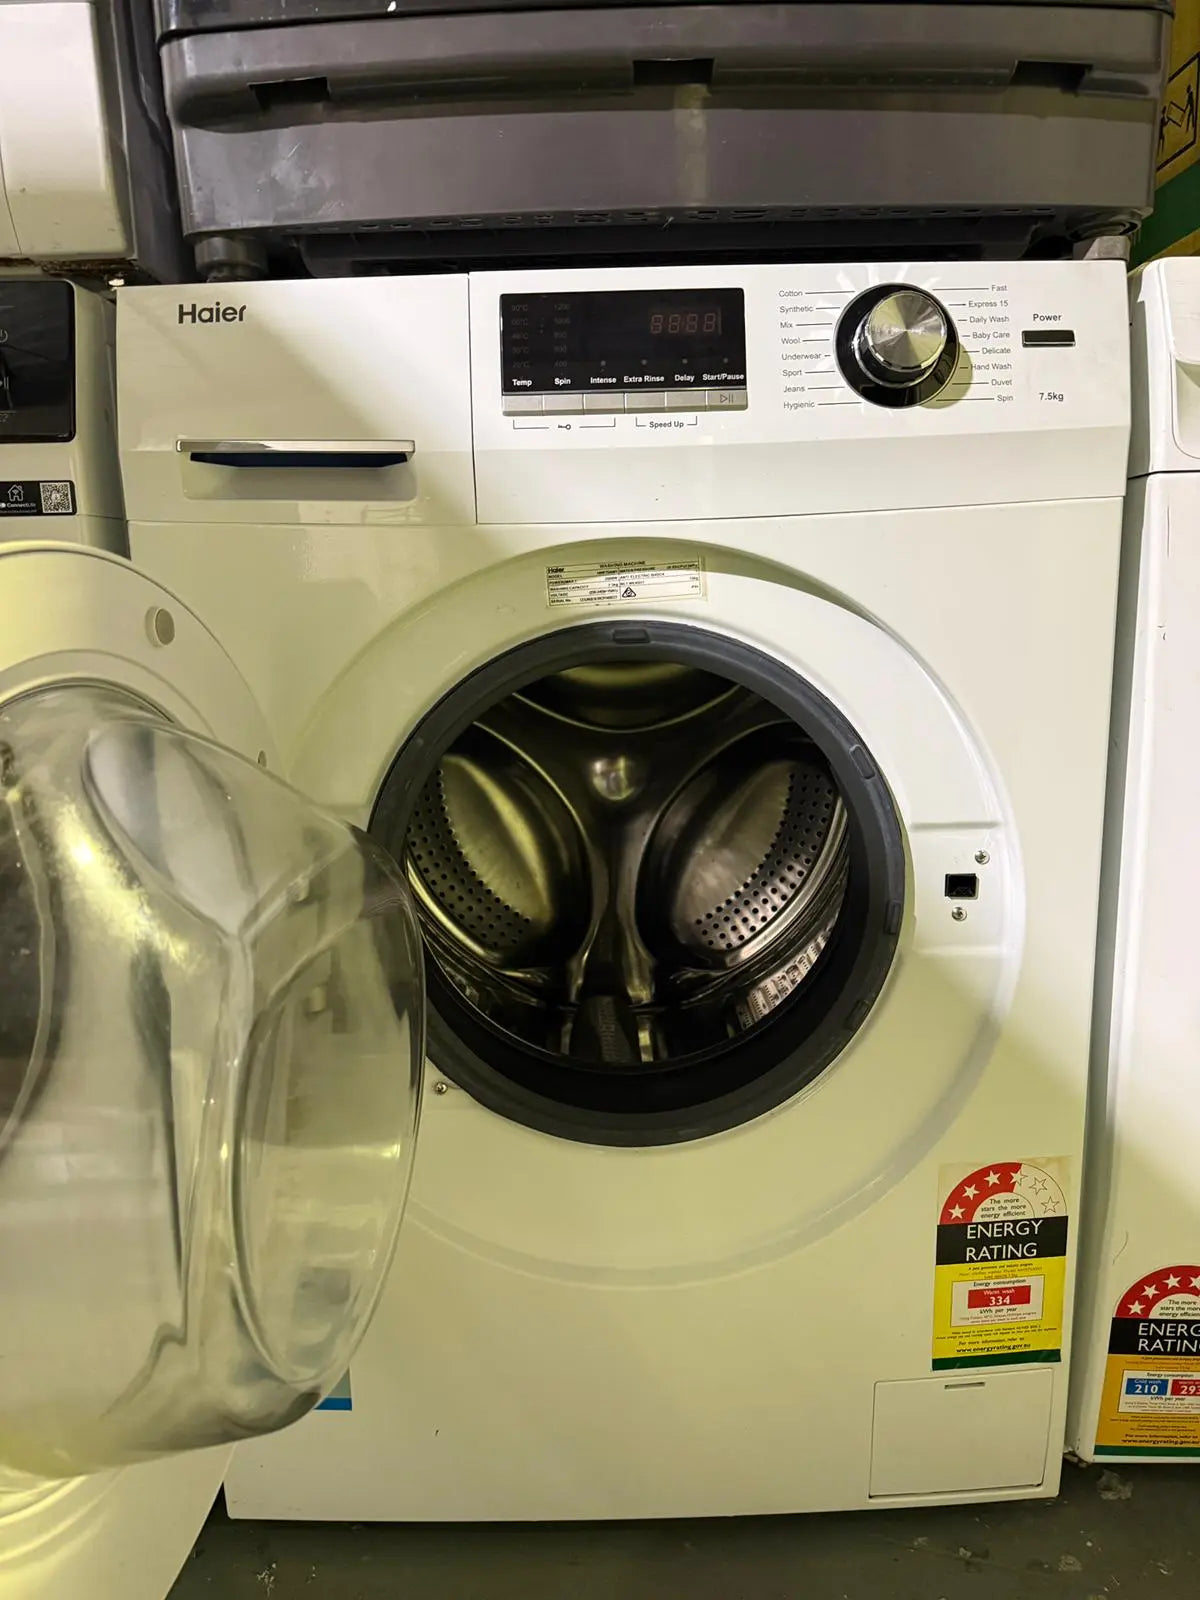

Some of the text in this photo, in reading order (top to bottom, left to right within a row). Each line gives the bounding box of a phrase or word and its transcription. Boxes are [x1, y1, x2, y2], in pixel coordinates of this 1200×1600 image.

[778, 290, 803, 298] Cotton
[968, 300, 997, 309] Express
[178, 301, 247, 324] Haier
[780, 305, 814, 314] Synthetic
[969, 316, 988, 324] Daily
[1032, 313, 1062, 322] Power
[780, 321, 793, 329] Mix
[972, 332, 990, 340] Baby
[781, 337, 801, 345] Wool
[982, 346, 1011, 355] Delicate
[782, 352, 822, 361] Underwear
[971, 362, 1012, 371] Hand Wash
[674, 373, 695, 382] Delay
[702, 372, 744, 382] Start/Pause
[782, 369, 802, 378] Sport
[512, 378, 532, 388] Temp
[554, 376, 572, 386] Spin
[590, 376, 616, 384] Intense
[623, 374, 664, 384] Extra Rinse
[991, 378, 1012, 386] Duvet
[783, 384, 806, 394] Jeans
[996, 394, 1014, 403] Spin
[1038, 392, 1064, 402] 7.5kg
[783, 400, 816, 410] Hygienic
[649, 420, 684, 430] Speed Up
[966, 1220, 1044, 1240] ENERGY
[966, 1242, 1038, 1262] RATING
[989, 1295, 1010, 1306] 334
[1138, 1338, 1200, 1352] RATIN
[1134, 1384, 1158, 1394] 210
